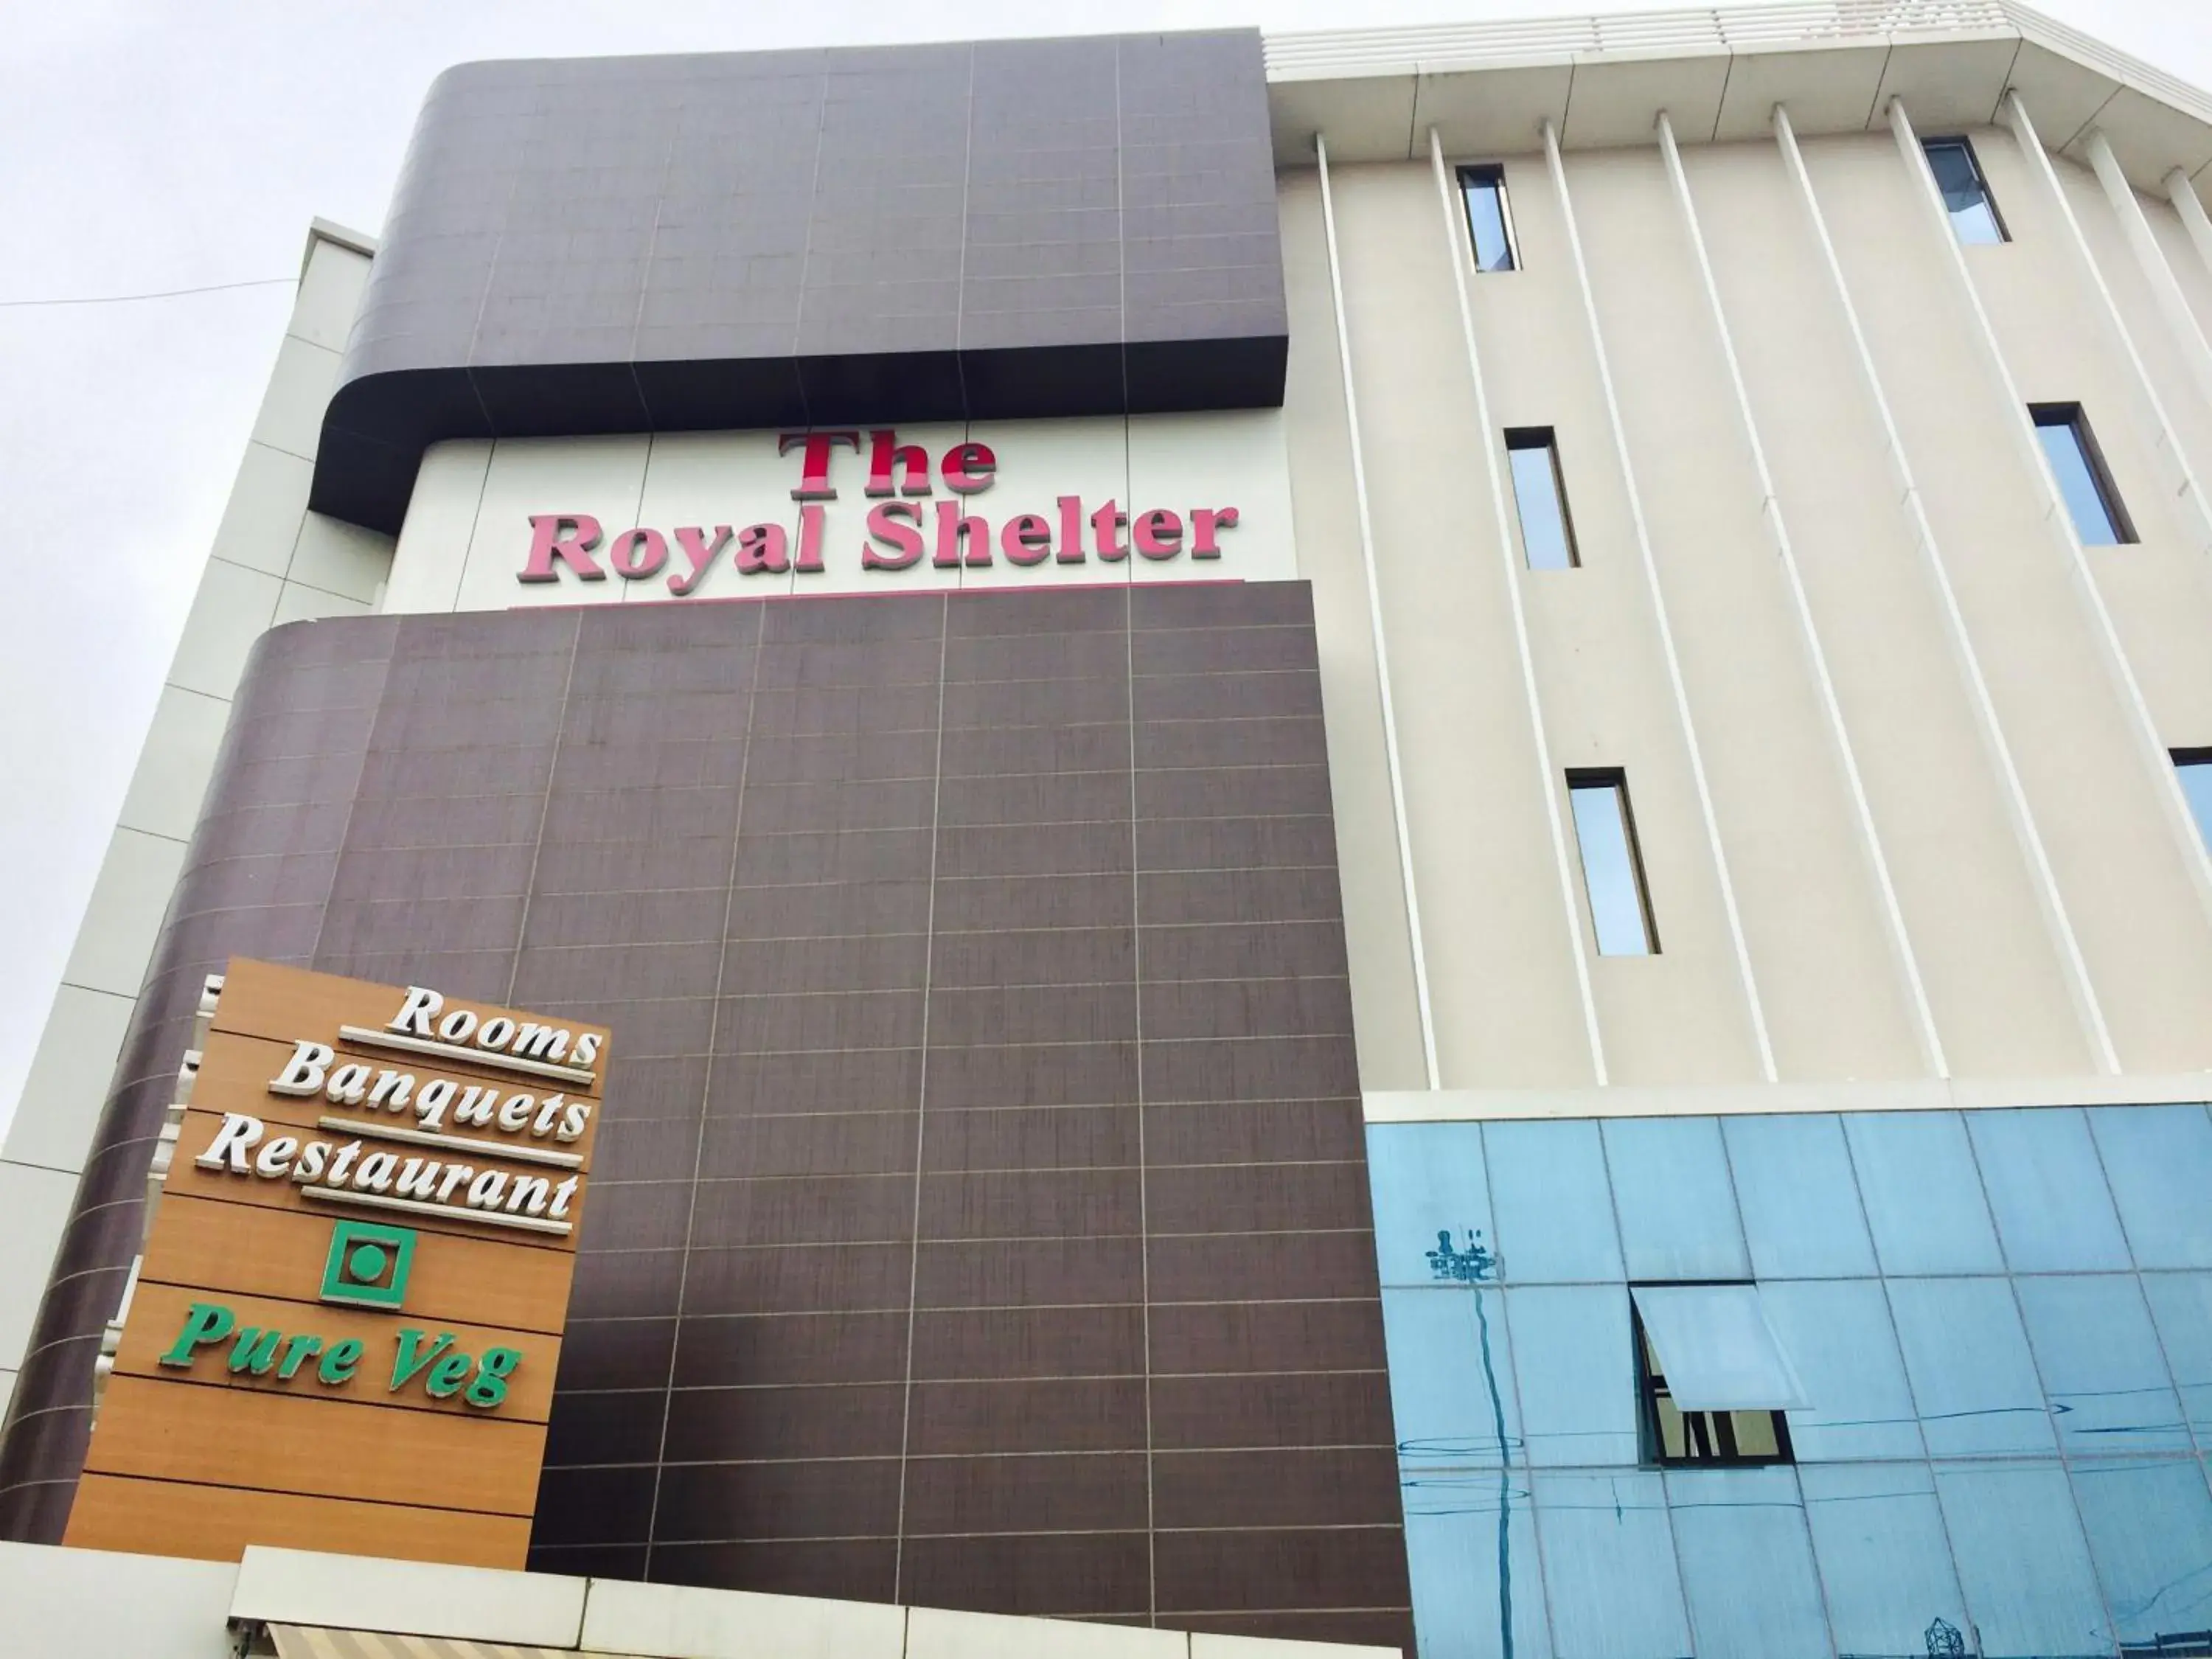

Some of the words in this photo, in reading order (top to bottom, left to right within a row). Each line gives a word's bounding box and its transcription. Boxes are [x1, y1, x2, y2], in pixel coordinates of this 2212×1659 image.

[779, 431, 997, 501] The
[517, 506, 826, 596] Royal
[862, 496, 1238, 571] Shelter
[385, 986, 602, 1068] Rooms
[268, 1040, 591, 1141] Banquets
[195, 1113, 578, 1219] Restaurant
[159, 1303, 364, 1383] Pure
[389, 1329, 521, 1407] Veg
